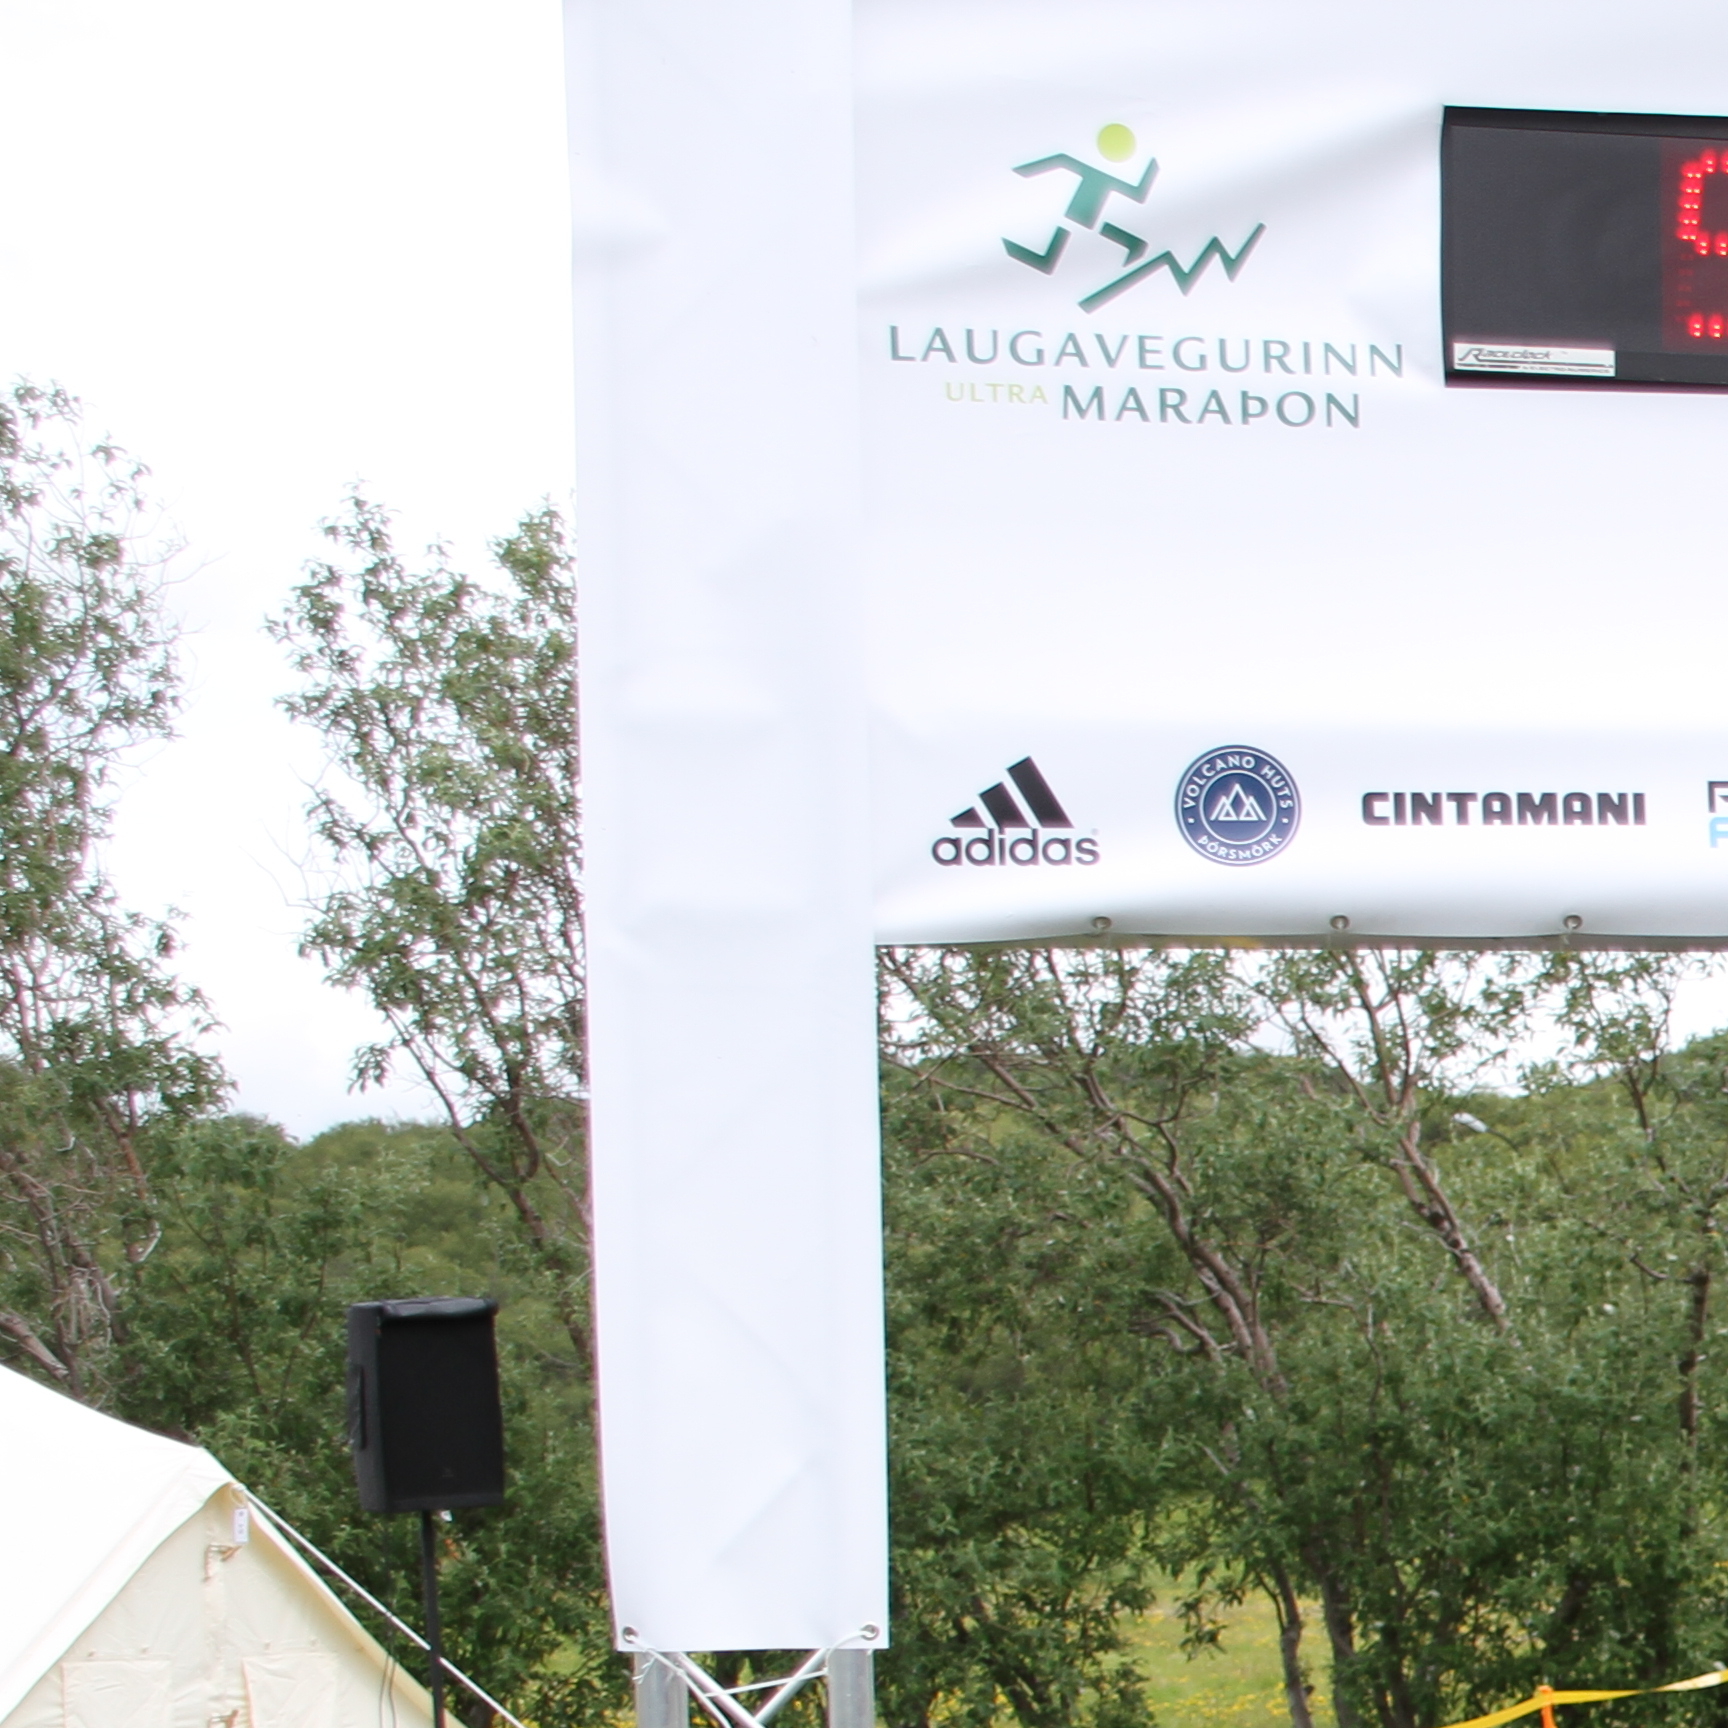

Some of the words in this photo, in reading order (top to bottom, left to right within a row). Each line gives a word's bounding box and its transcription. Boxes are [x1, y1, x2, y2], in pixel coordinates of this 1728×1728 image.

[889, 325, 1403, 377] LAUGAVEGURINN
[945, 381, 1048, 405] ULTRA
[1062, 384, 1360, 429] MARAÞON
[1182, 754, 1256, 809] VOLCANO
[1260, 764, 1294, 809] HUTS
[1361, 791, 1647, 826] CINTAMANI
[931, 827, 1100, 867] adidas
[1197, 833, 1283, 860] ÞÓRSMÖRK
